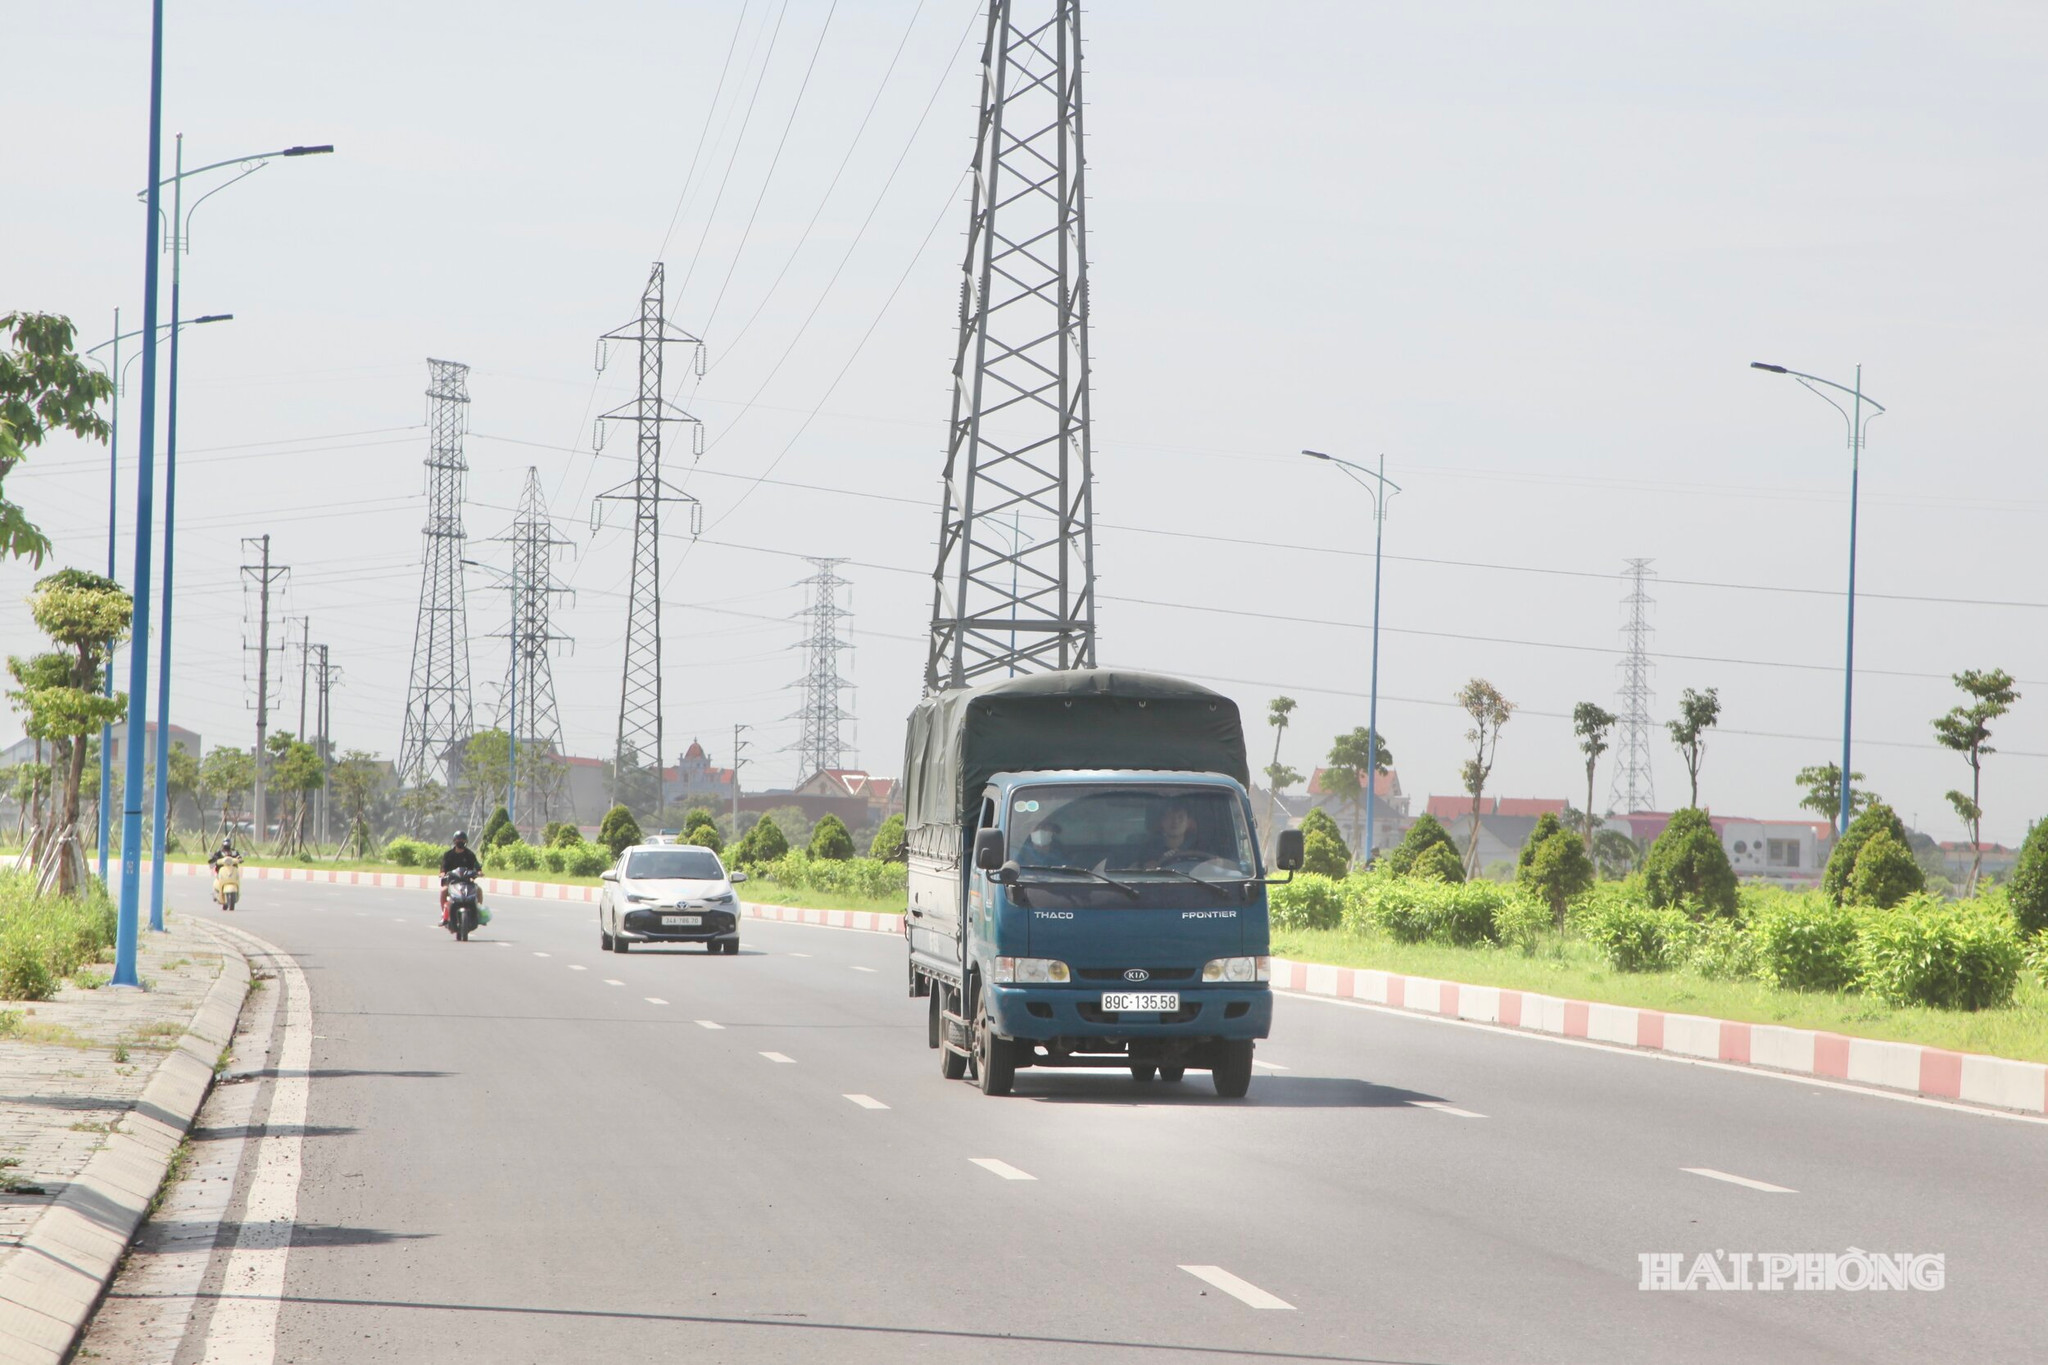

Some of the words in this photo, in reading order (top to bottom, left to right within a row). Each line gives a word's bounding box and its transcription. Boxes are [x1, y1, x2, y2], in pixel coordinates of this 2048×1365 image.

[1034, 911, 1074, 919] THACO
[1182, 911, 1237, 919] FRONTIER
[1128, 971, 1145, 979] KIA
